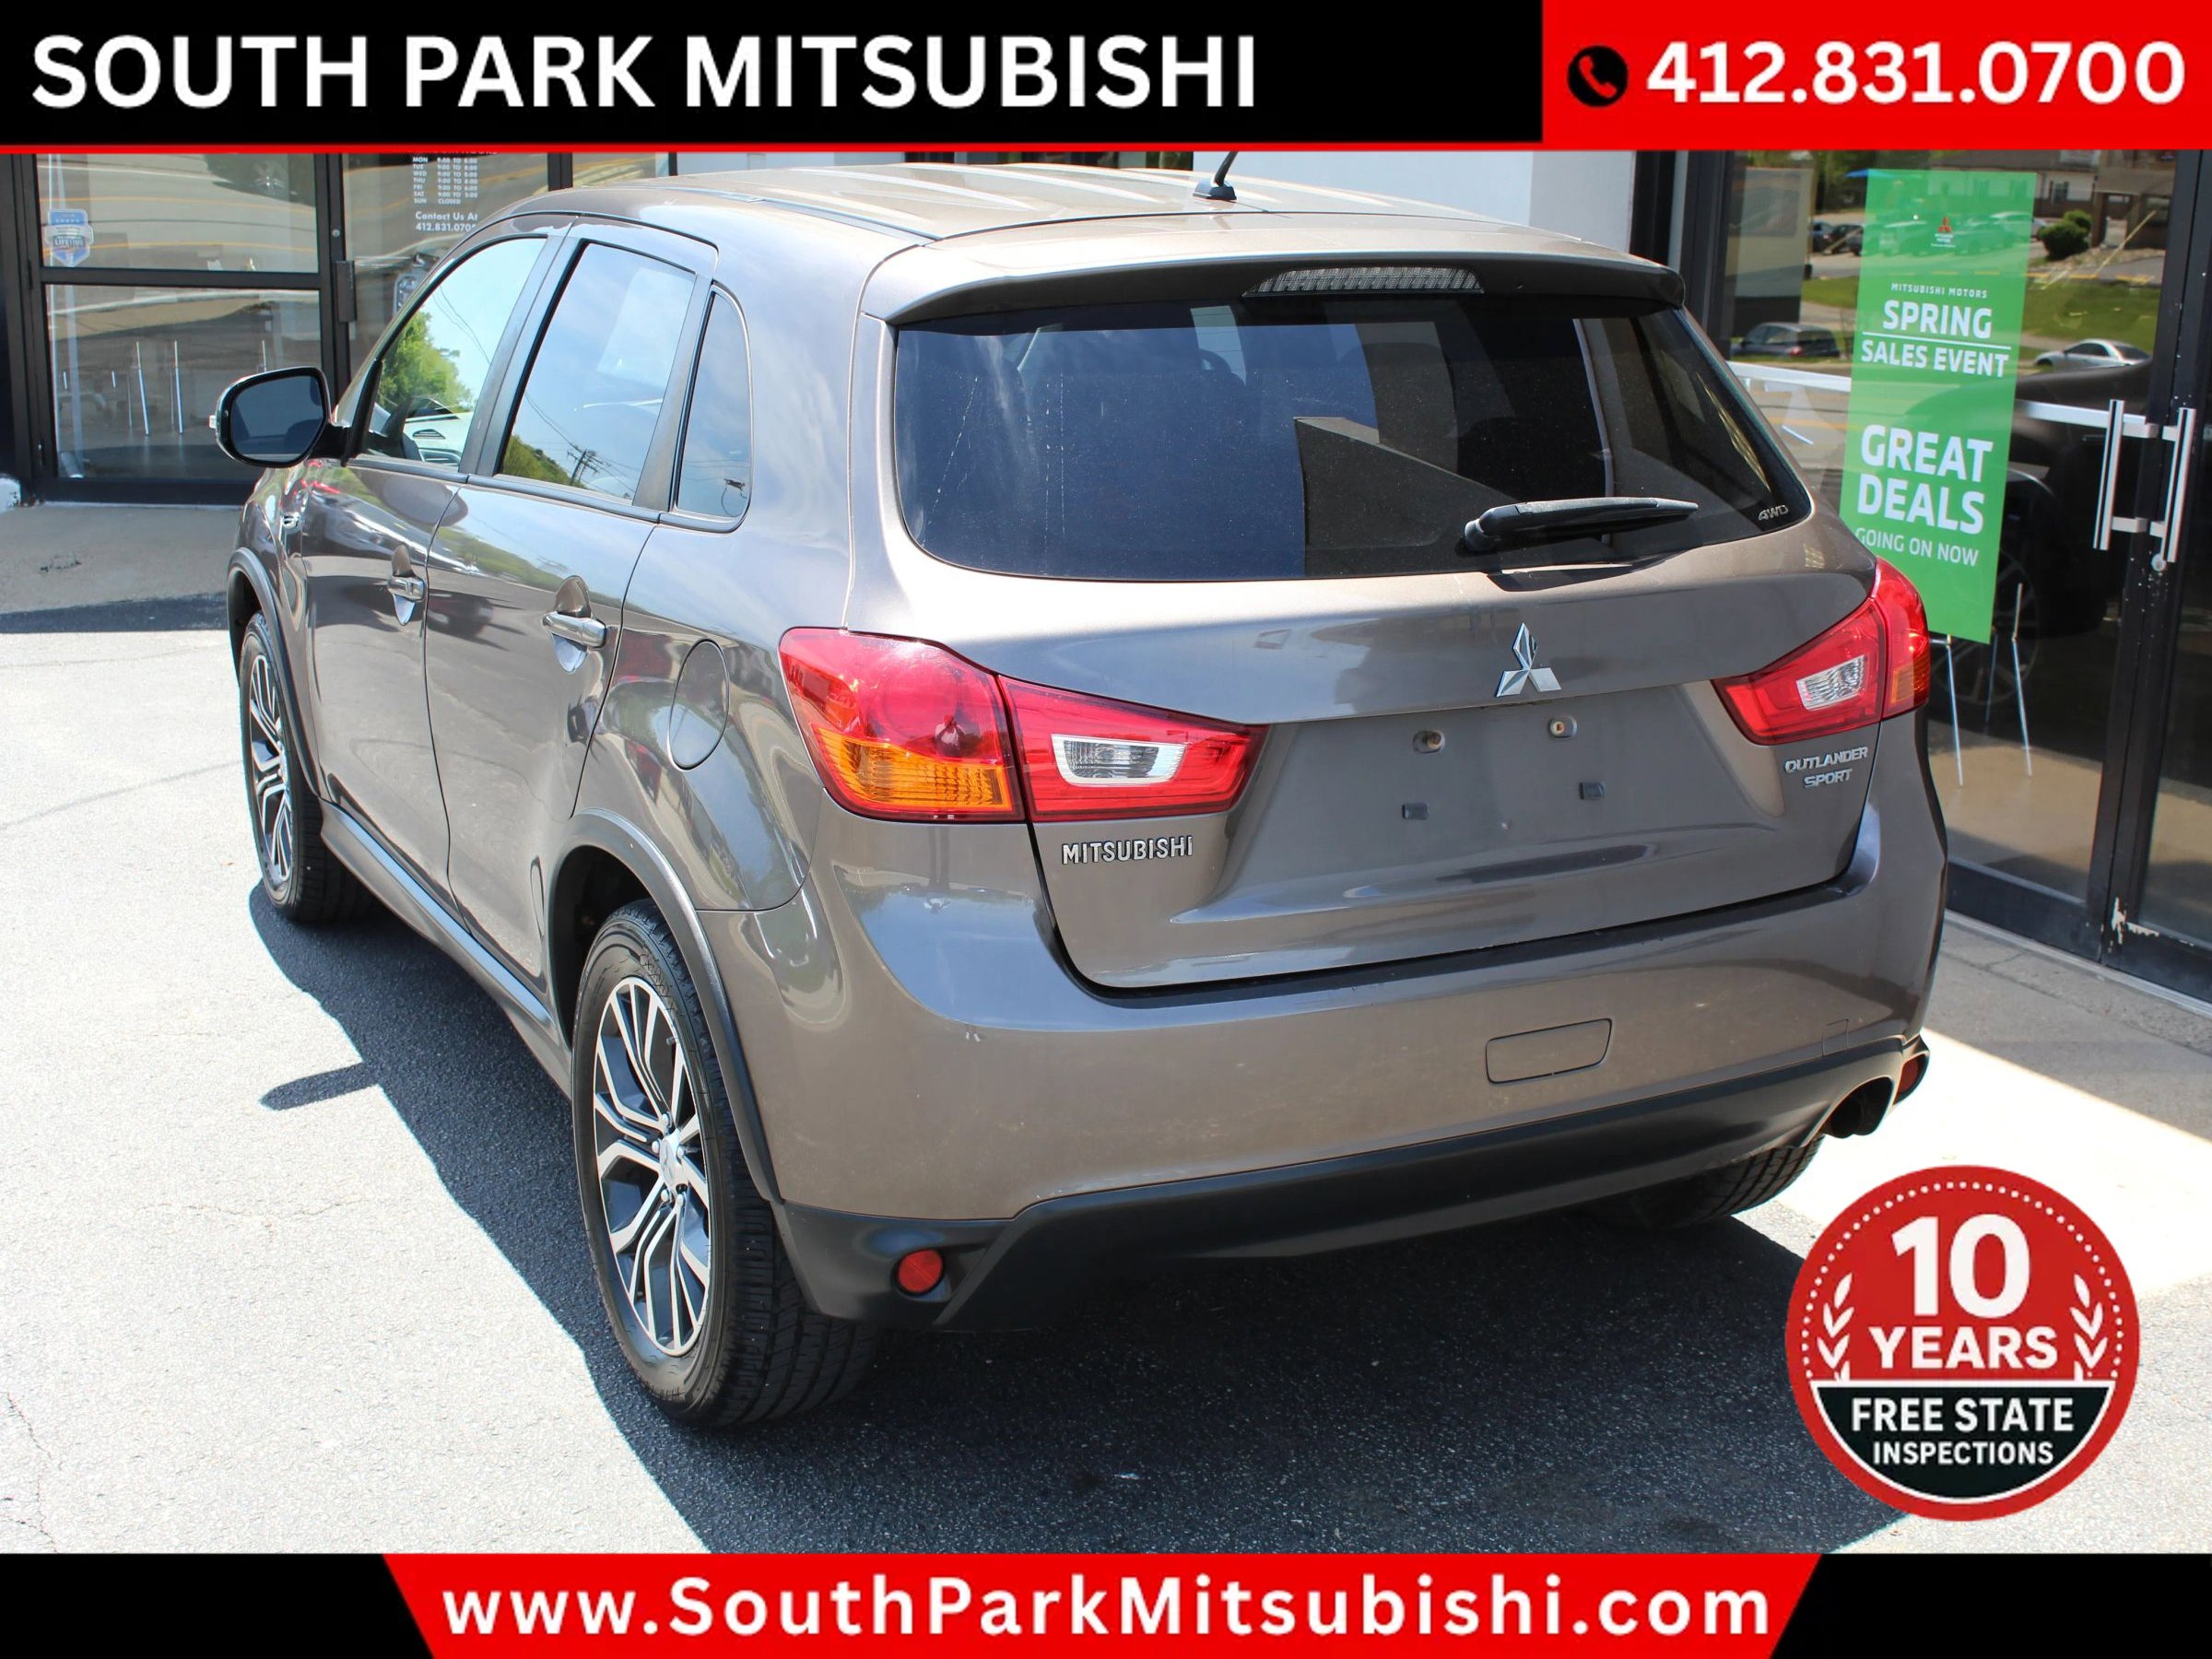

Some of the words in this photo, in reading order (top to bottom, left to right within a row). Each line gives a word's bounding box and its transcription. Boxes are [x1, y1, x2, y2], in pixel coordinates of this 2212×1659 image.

[415, 211, 451, 220] Contact
[453, 212, 465, 221] Us
[467, 212, 478, 221] At
[1890, 283, 1946, 296] MITSUBISHI
[1947, 287, 1988, 300] MOTORS
[1882, 299, 1993, 339] SPRING
[1860, 338, 1928, 370] SALES
[1933, 347, 2010, 378] EVENT
[1860, 424, 1994, 483] GREAT
[1758, 504, 1789, 521] 4WD
[1856, 472, 1985, 535] DEALS
[1854, 526, 1905, 553] GOING
[1909, 536, 1934, 559] ON
[1936, 542, 1980, 568] NOW
[1784, 746, 1869, 773] OUTLANDER
[1804, 768, 1853, 789] SPORT
[1062, 835, 1194, 865] MITSUBISHI
